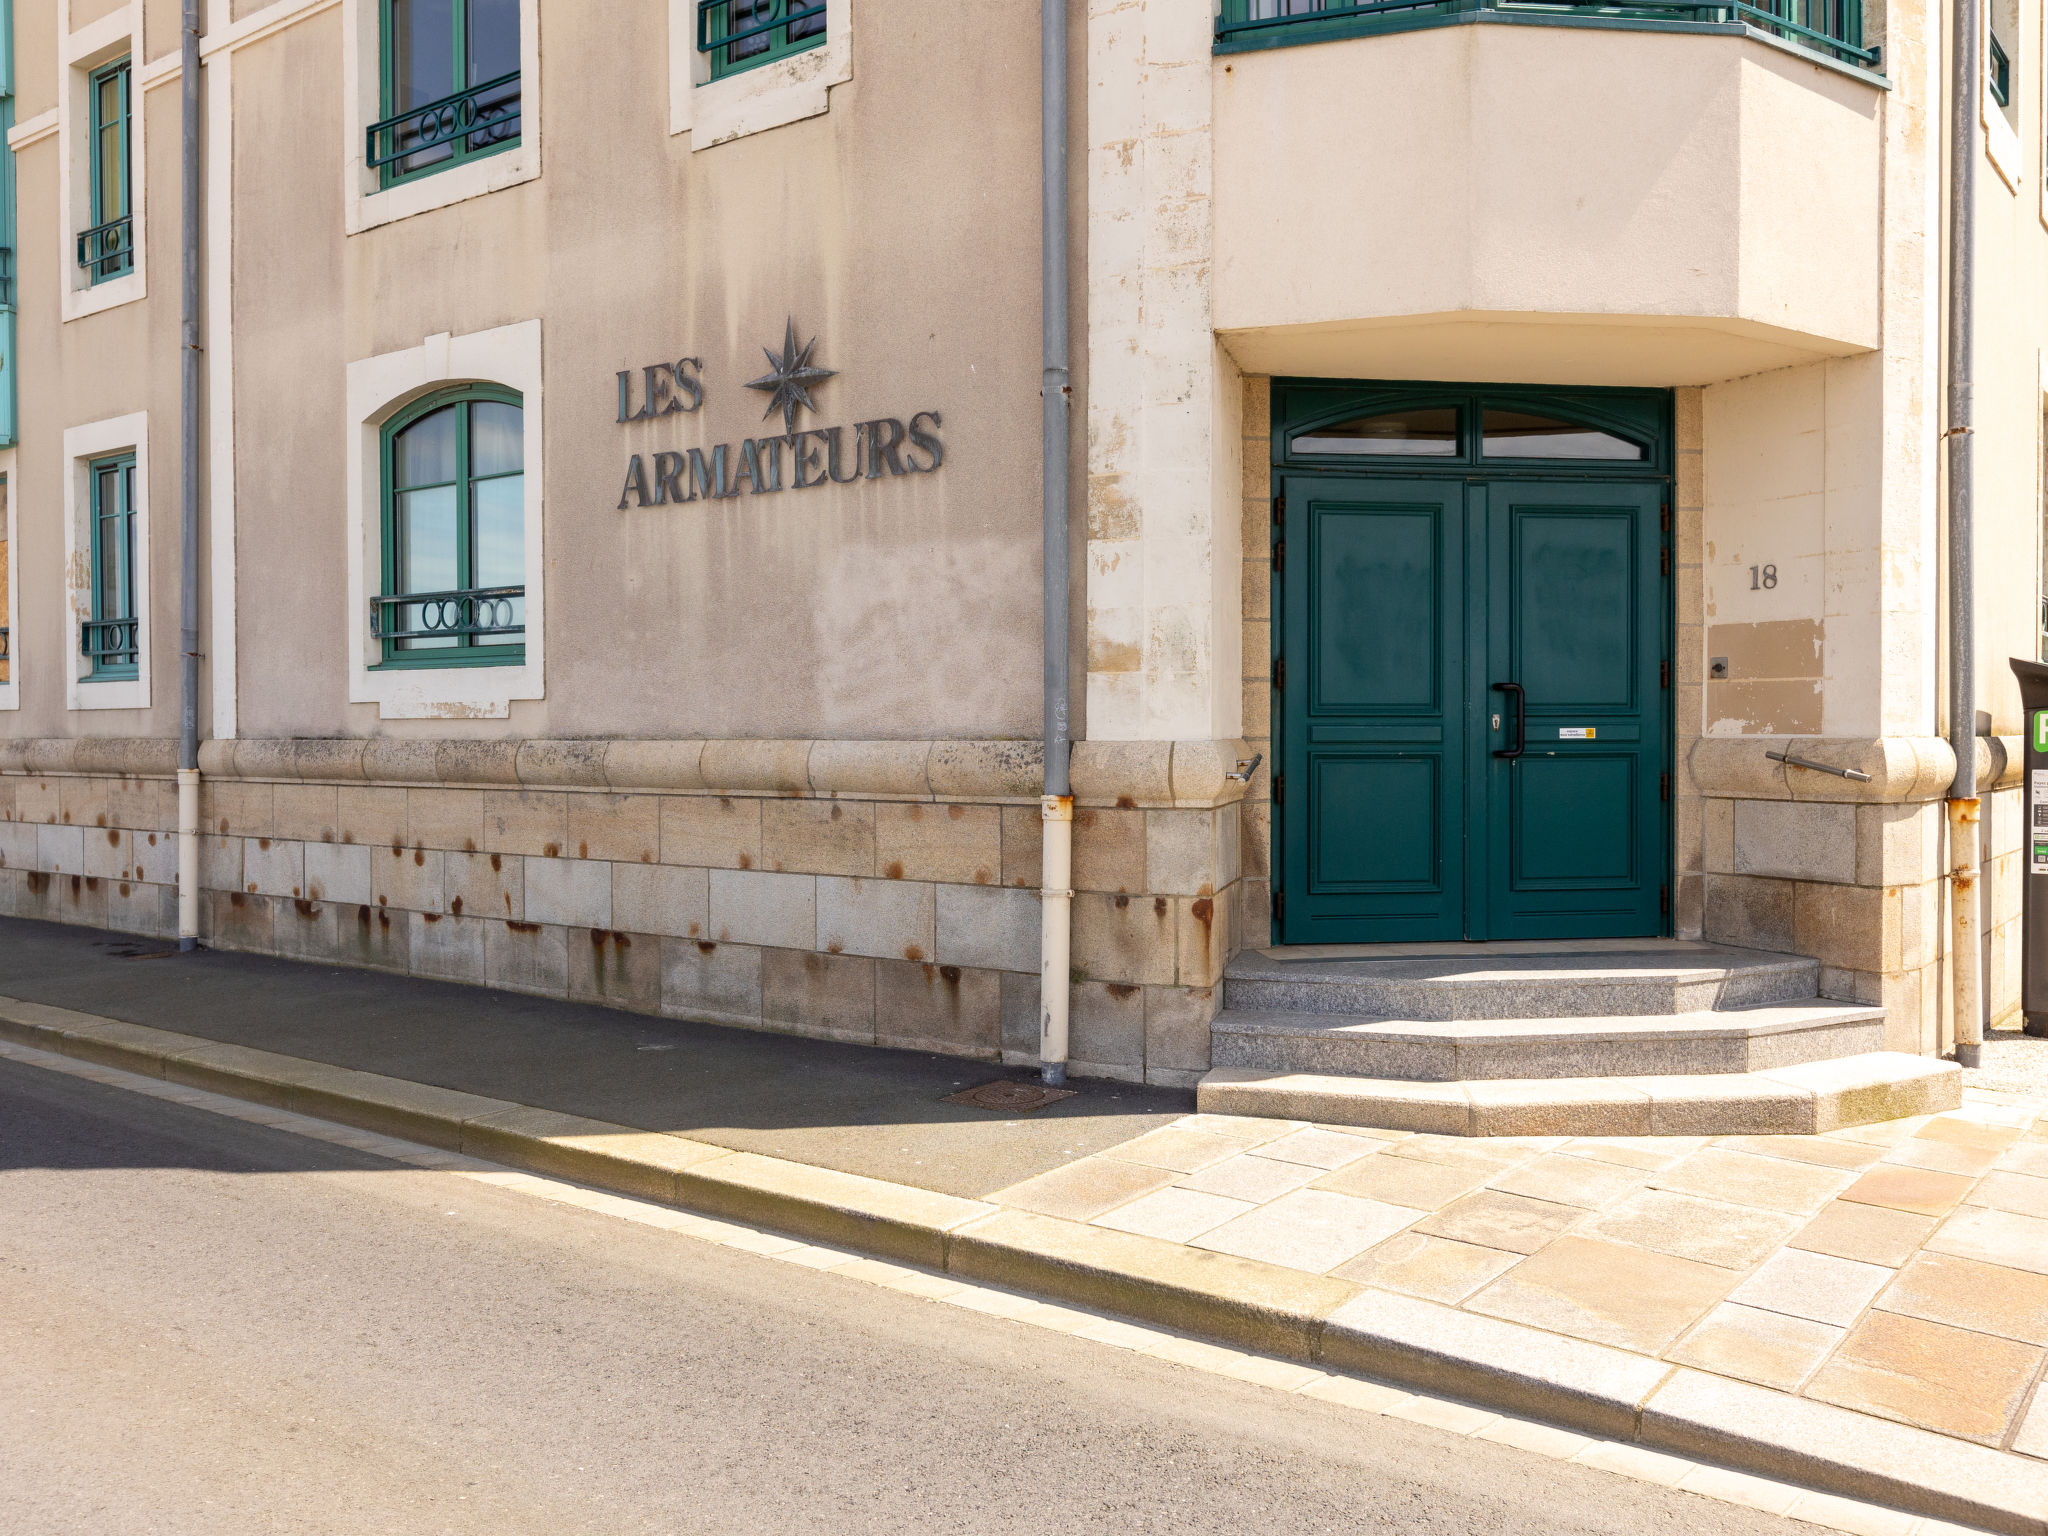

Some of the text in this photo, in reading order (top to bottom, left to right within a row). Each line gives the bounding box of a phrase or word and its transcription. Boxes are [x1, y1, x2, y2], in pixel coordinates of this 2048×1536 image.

[616, 357, 702, 423] LES
[617, 410, 943, 510] ARMATEURS
[1749, 564, 1777, 590] 18
